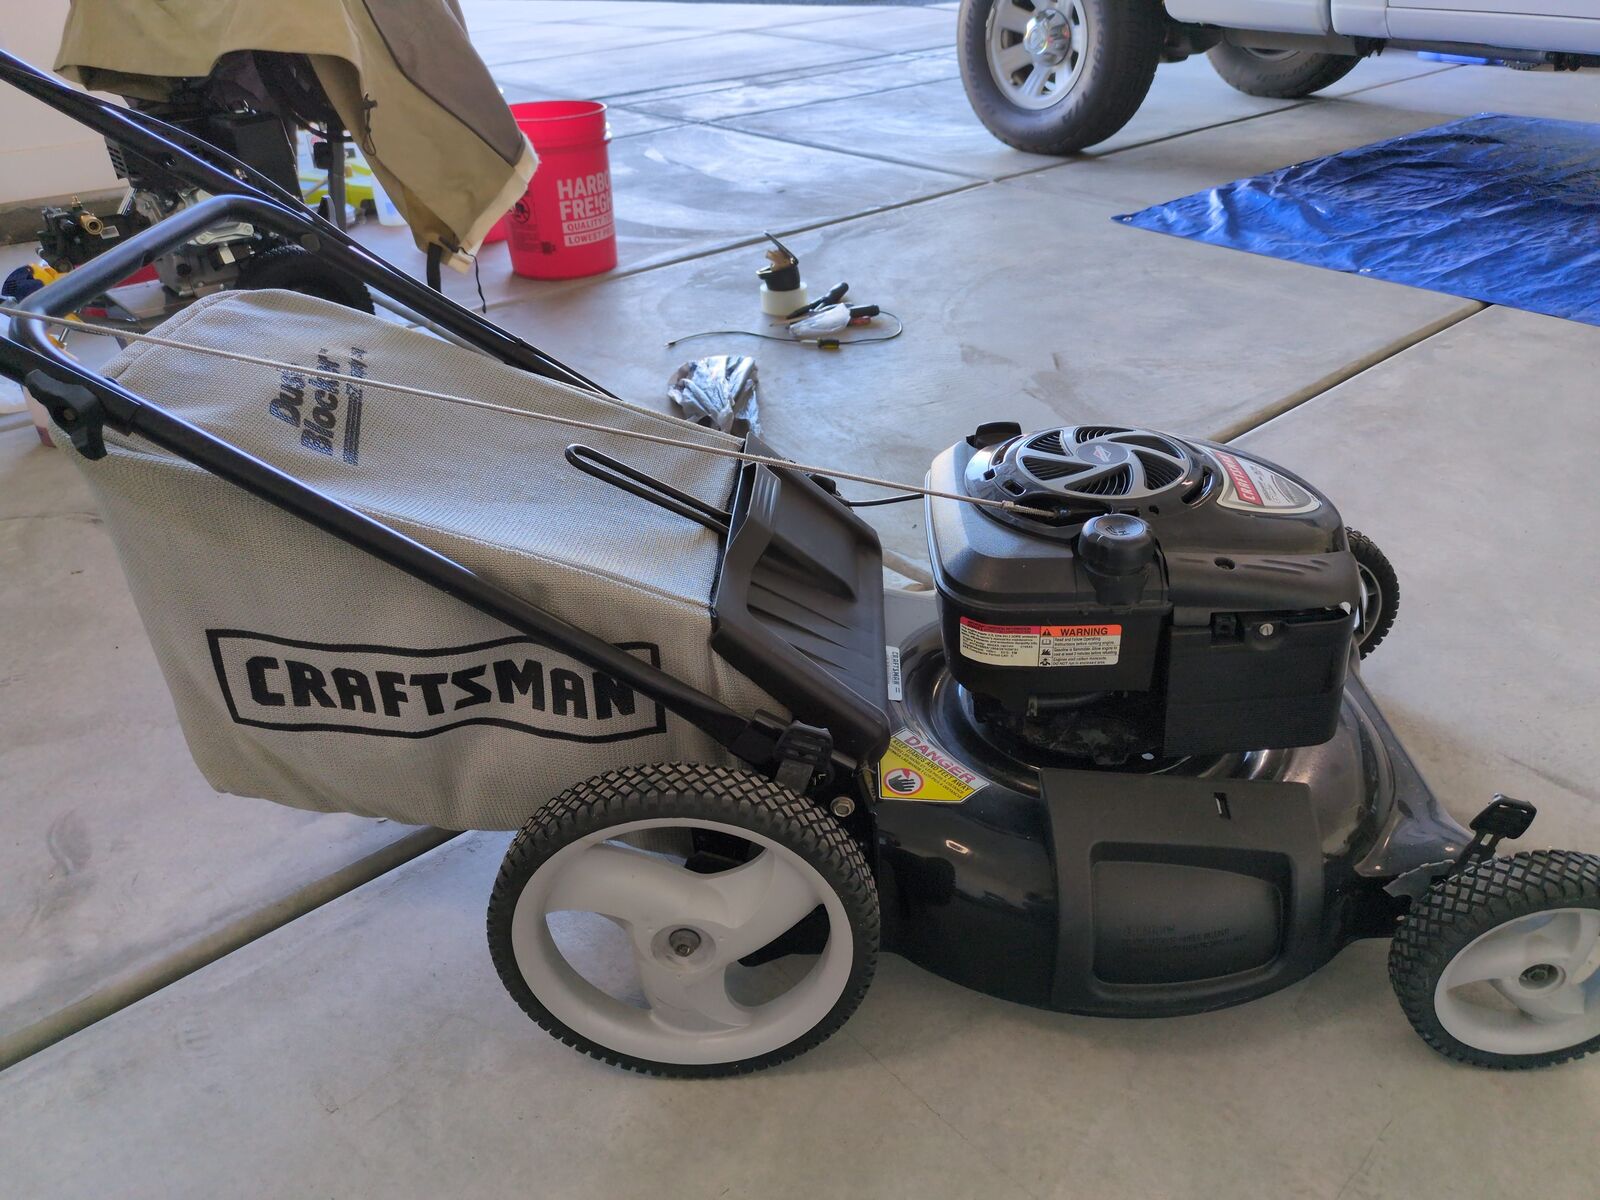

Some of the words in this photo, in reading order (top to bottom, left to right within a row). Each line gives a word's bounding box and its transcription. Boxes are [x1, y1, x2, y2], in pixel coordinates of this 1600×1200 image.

[566, 218, 602, 231] QUALITY
[1060, 627, 1108, 637] WARNING
[244, 656, 636, 720] CRAFTSMAN
[904, 735, 976, 784] DANGER
[906, 748, 925, 763] HANDS
[925, 761, 939, 772] AND
[939, 768, 953, 780] FEET
[951, 779, 970, 792] AWAY
